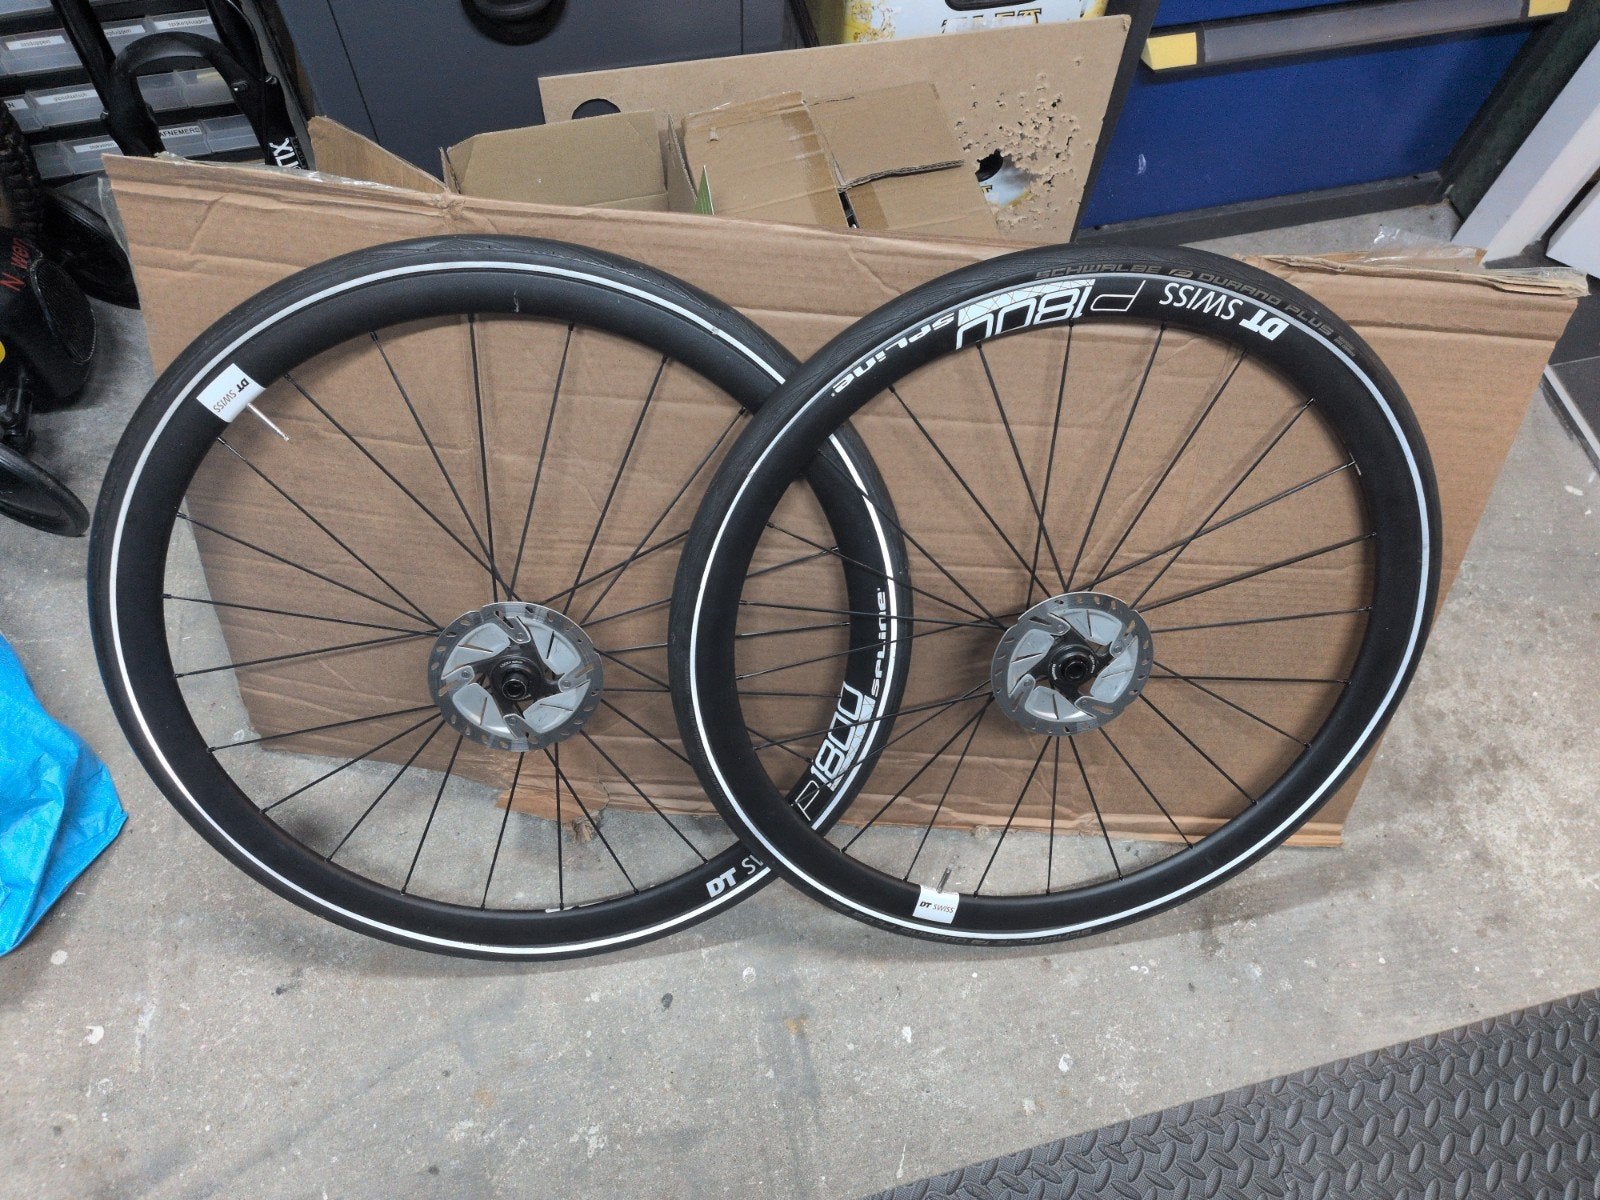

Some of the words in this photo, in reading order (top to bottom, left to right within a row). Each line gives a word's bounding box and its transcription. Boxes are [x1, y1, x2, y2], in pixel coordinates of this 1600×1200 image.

[956, 278, 1096, 350] 1800
[1034, 263, 1162, 280] SCHWALBE
[1284, 303, 1334, 335] PLUS
[1159, 282, 1244, 320] SWISS
[1238, 308, 1290, 341] DT
[213, 390, 237, 412] SWISS
[236, 378, 250, 392] DT
[705, 866, 737, 898] DT
[810, 680, 866, 791] 1800
[919, 901, 932, 909] DT
[933, 904, 955, 913] SWISS
